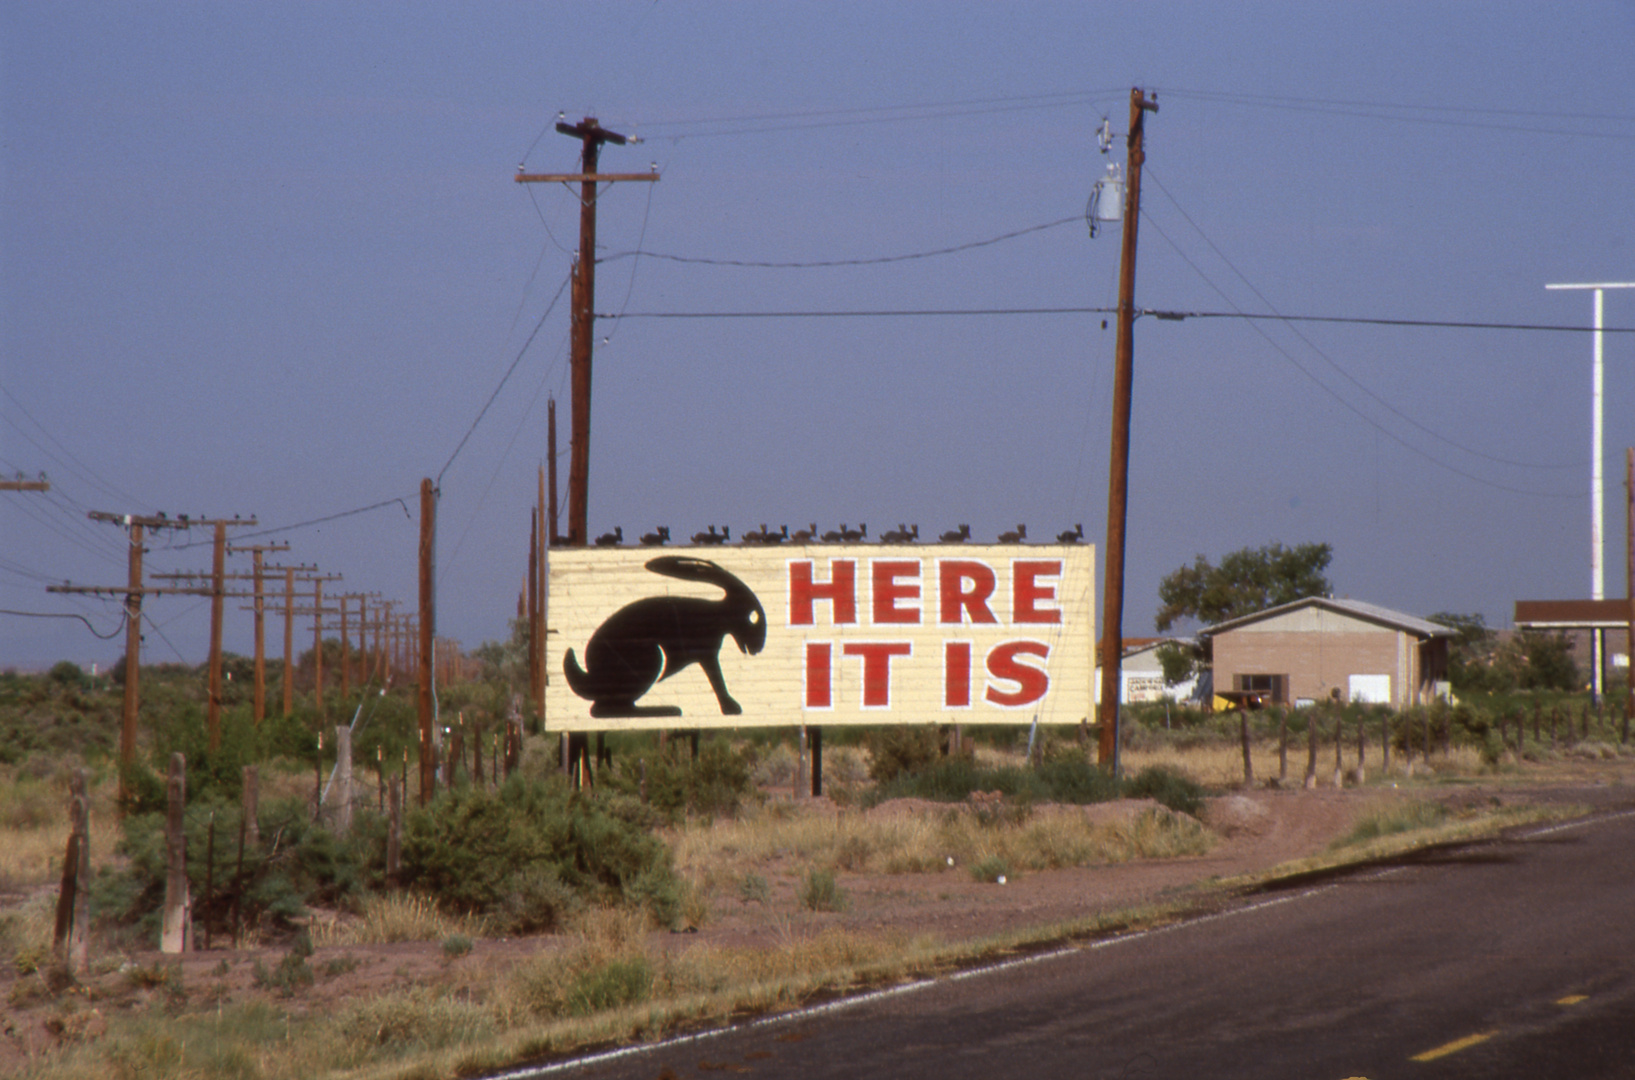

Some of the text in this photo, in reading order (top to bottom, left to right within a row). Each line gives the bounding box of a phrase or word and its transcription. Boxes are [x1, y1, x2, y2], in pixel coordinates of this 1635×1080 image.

[788, 559, 1062, 626] HERE
[804, 640, 1050, 708] IT IS
